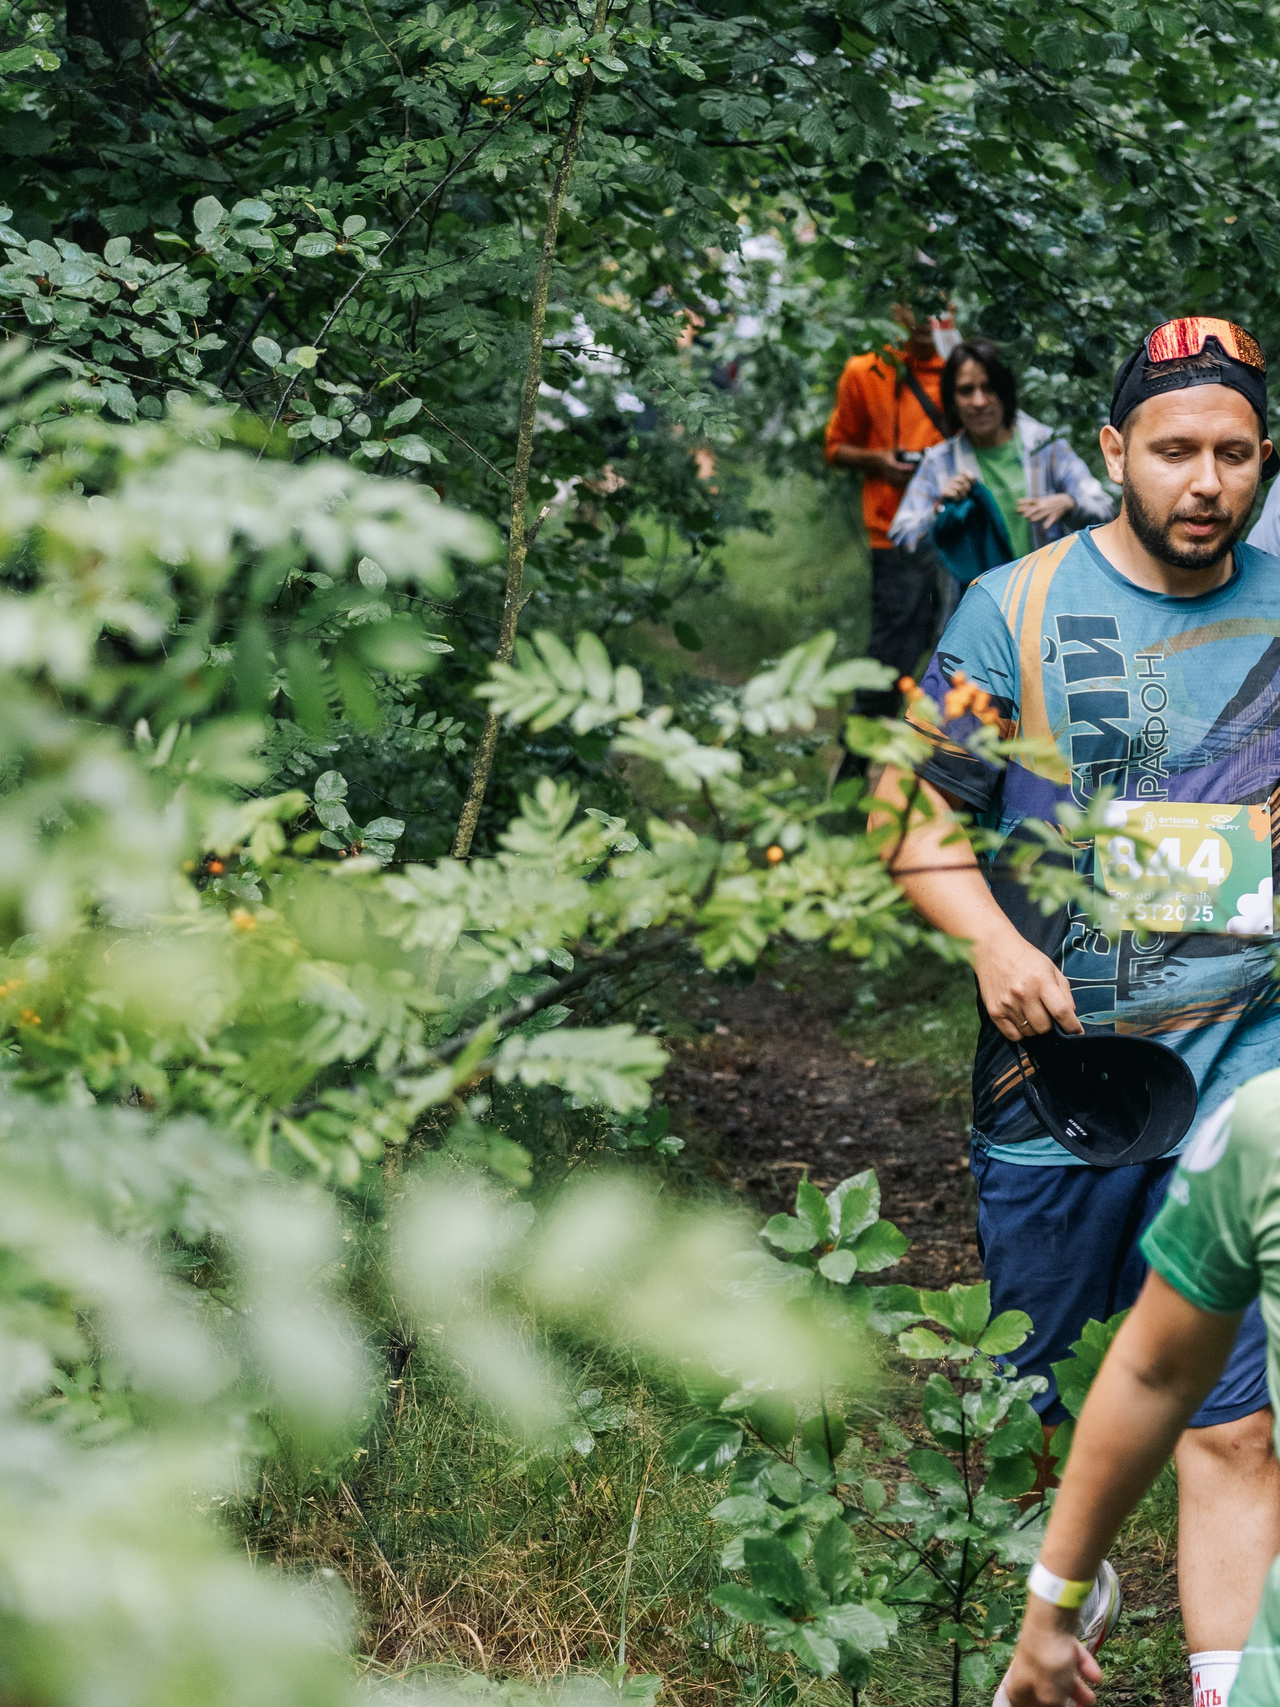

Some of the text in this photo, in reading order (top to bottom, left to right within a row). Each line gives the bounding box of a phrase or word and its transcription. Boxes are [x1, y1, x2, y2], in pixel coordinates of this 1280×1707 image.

[1158, 817, 1200, 825] ФУТБОЛИКА
[1205, 823, 1240, 831] CHERY
[1105, 835, 1225, 886] 844
[1109, 903, 1214, 922] FST2025
